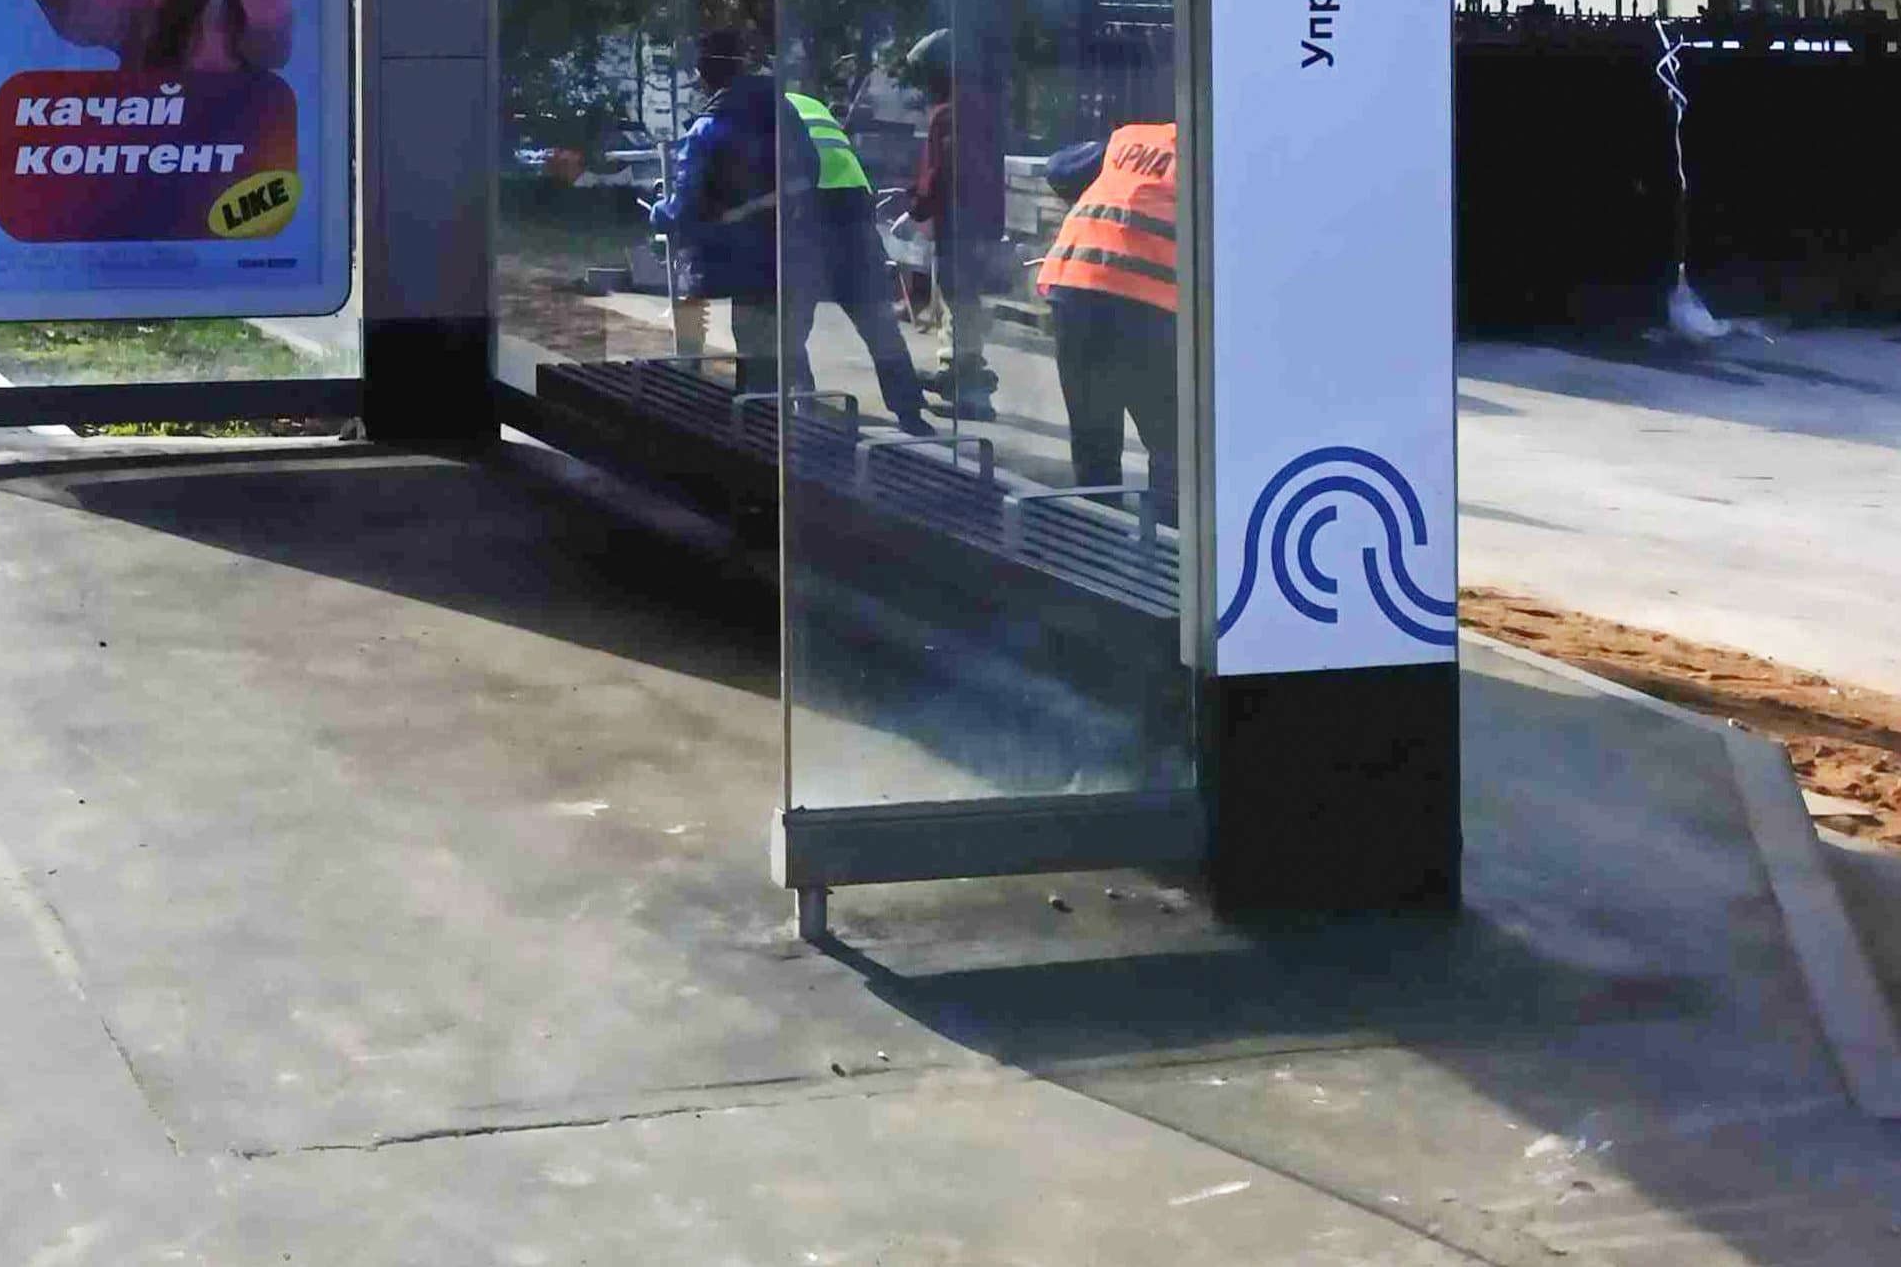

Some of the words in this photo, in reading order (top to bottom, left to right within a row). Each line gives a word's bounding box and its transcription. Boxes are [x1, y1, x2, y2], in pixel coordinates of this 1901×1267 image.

[14, 83, 185, 126] качай
[14, 144, 244, 175] контент
[221, 177, 290, 231] LIKE
